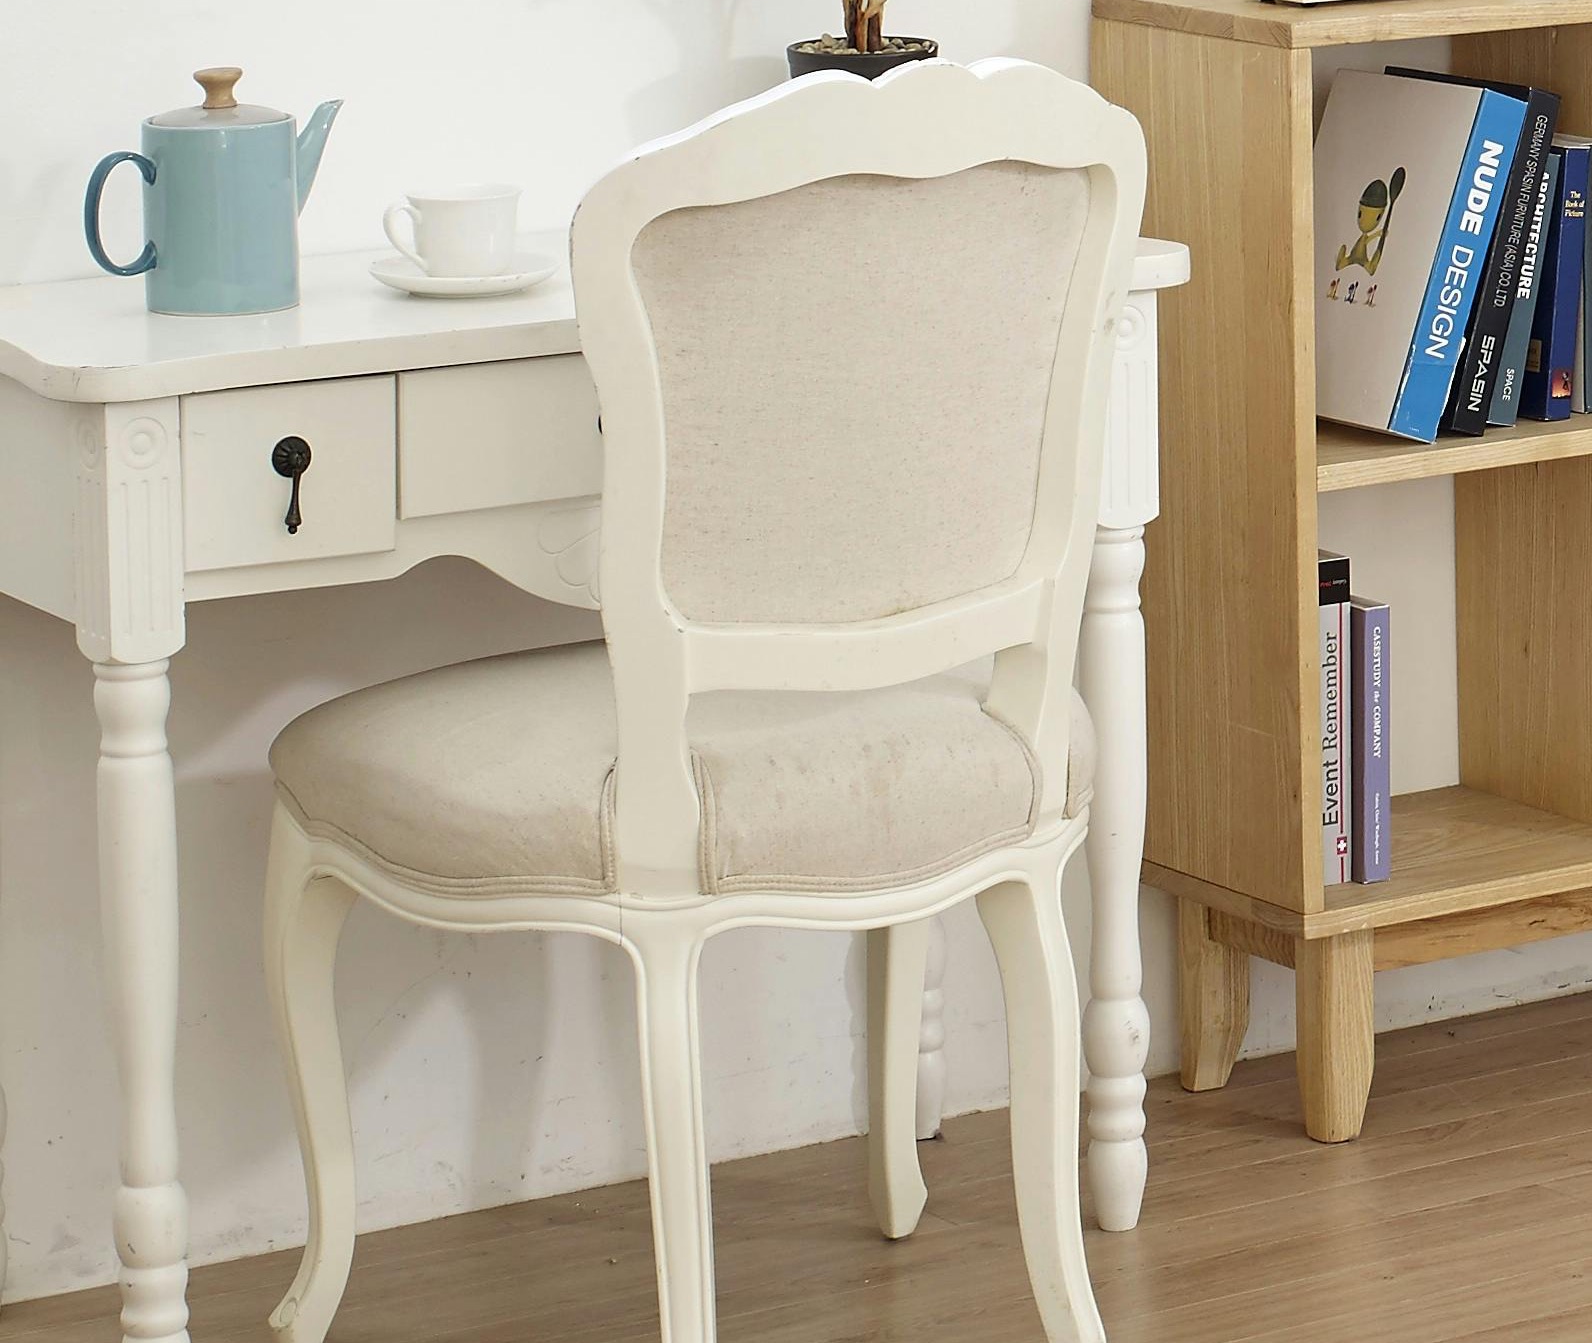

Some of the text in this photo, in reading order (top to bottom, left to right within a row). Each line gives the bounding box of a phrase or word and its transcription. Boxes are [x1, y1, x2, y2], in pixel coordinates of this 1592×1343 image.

[1529, 115, 1548, 160] GERMANY
[1520, 159, 1538, 194] SPASIN
[1507, 193, 1530, 245] FURNITURE
[1424, 139, 1504, 359] NUDE DESIGN
[1500, 244, 1518, 272] (ASIA)
[1468, 335, 1495, 412] SPASIN
[1502, 368, 1515, 401] SPACE
[1373, 626, 1381, 688] CASESTUDY
[1321, 631, 1339, 827] Event Remember
[1373, 704, 1381, 758] COMPANY
